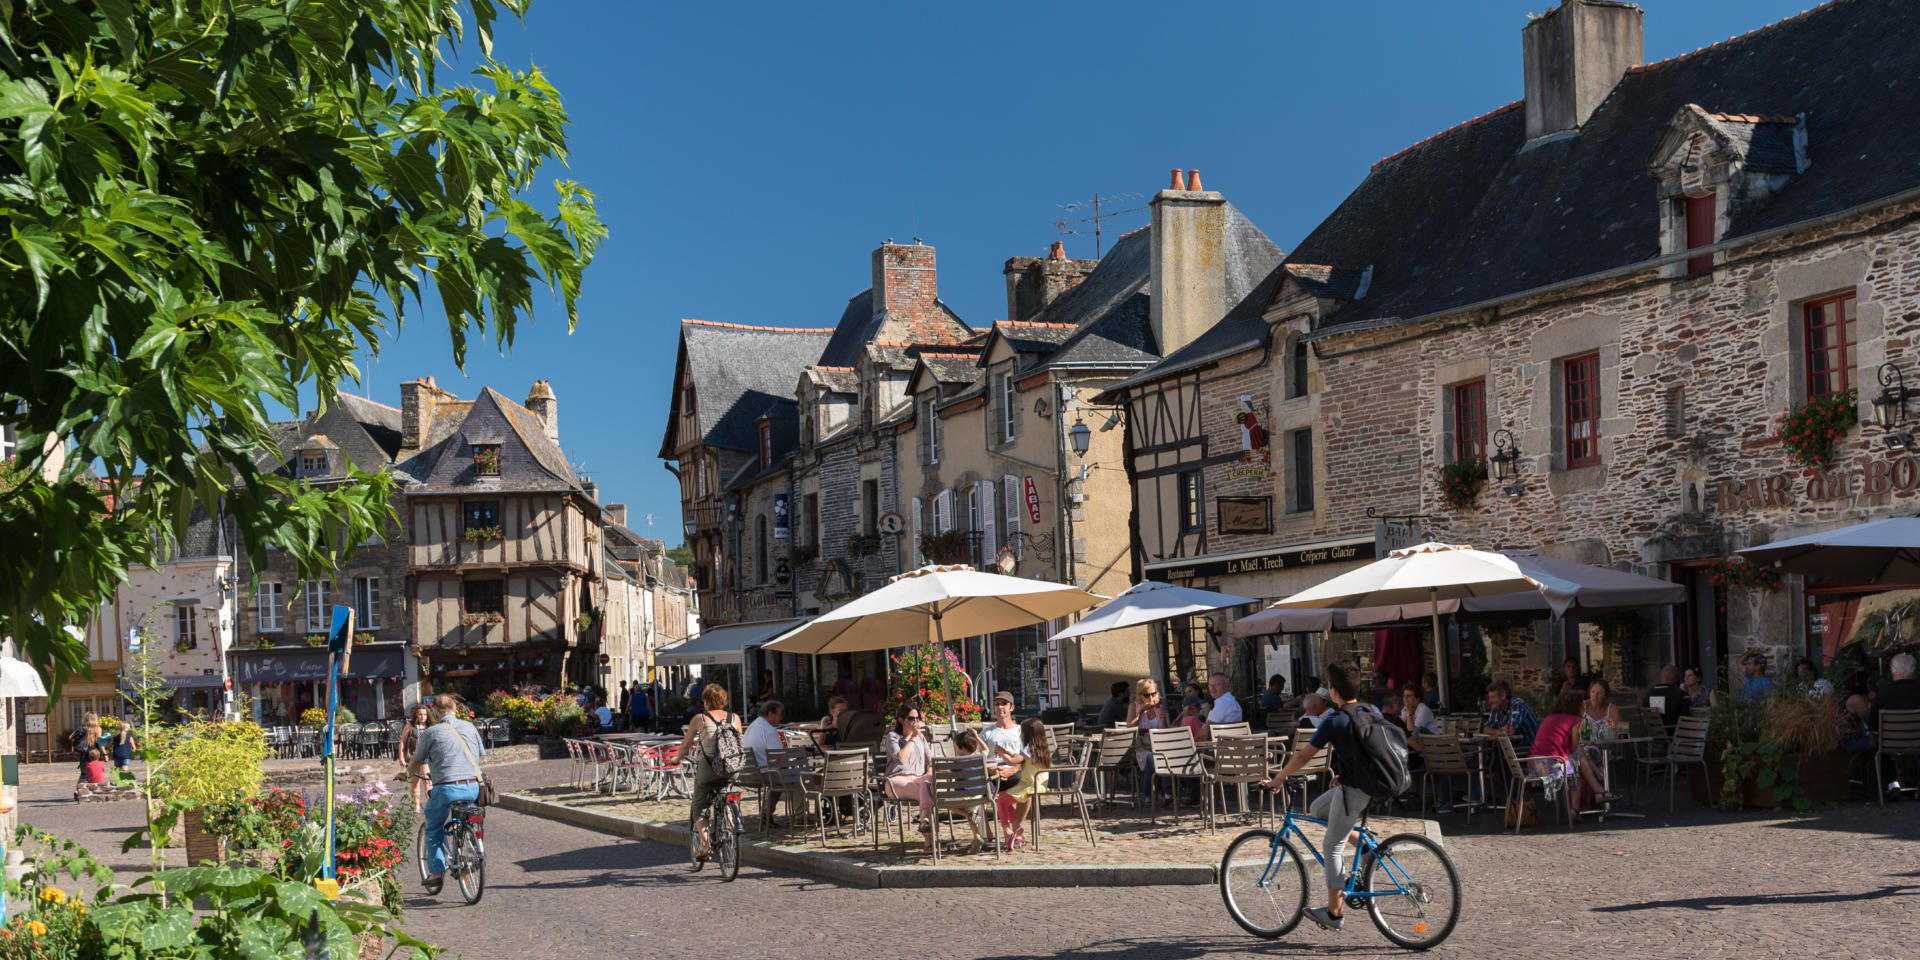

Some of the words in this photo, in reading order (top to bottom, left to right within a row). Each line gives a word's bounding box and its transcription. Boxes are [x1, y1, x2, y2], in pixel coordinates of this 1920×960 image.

[1026, 477, 1040, 521] TABAC
[1716, 475, 1794, 512] BAR
[1806, 472, 1850, 500] du
[1862, 456, 1919, 495] BO
[1387, 526, 1409, 538] BAR
[1227, 561, 1237, 573] Le
[1262, 555, 1284, 569] Trech
[1300, 549, 1328, 565] Crêperie
[1331, 546, 1356, 559] Glacier
